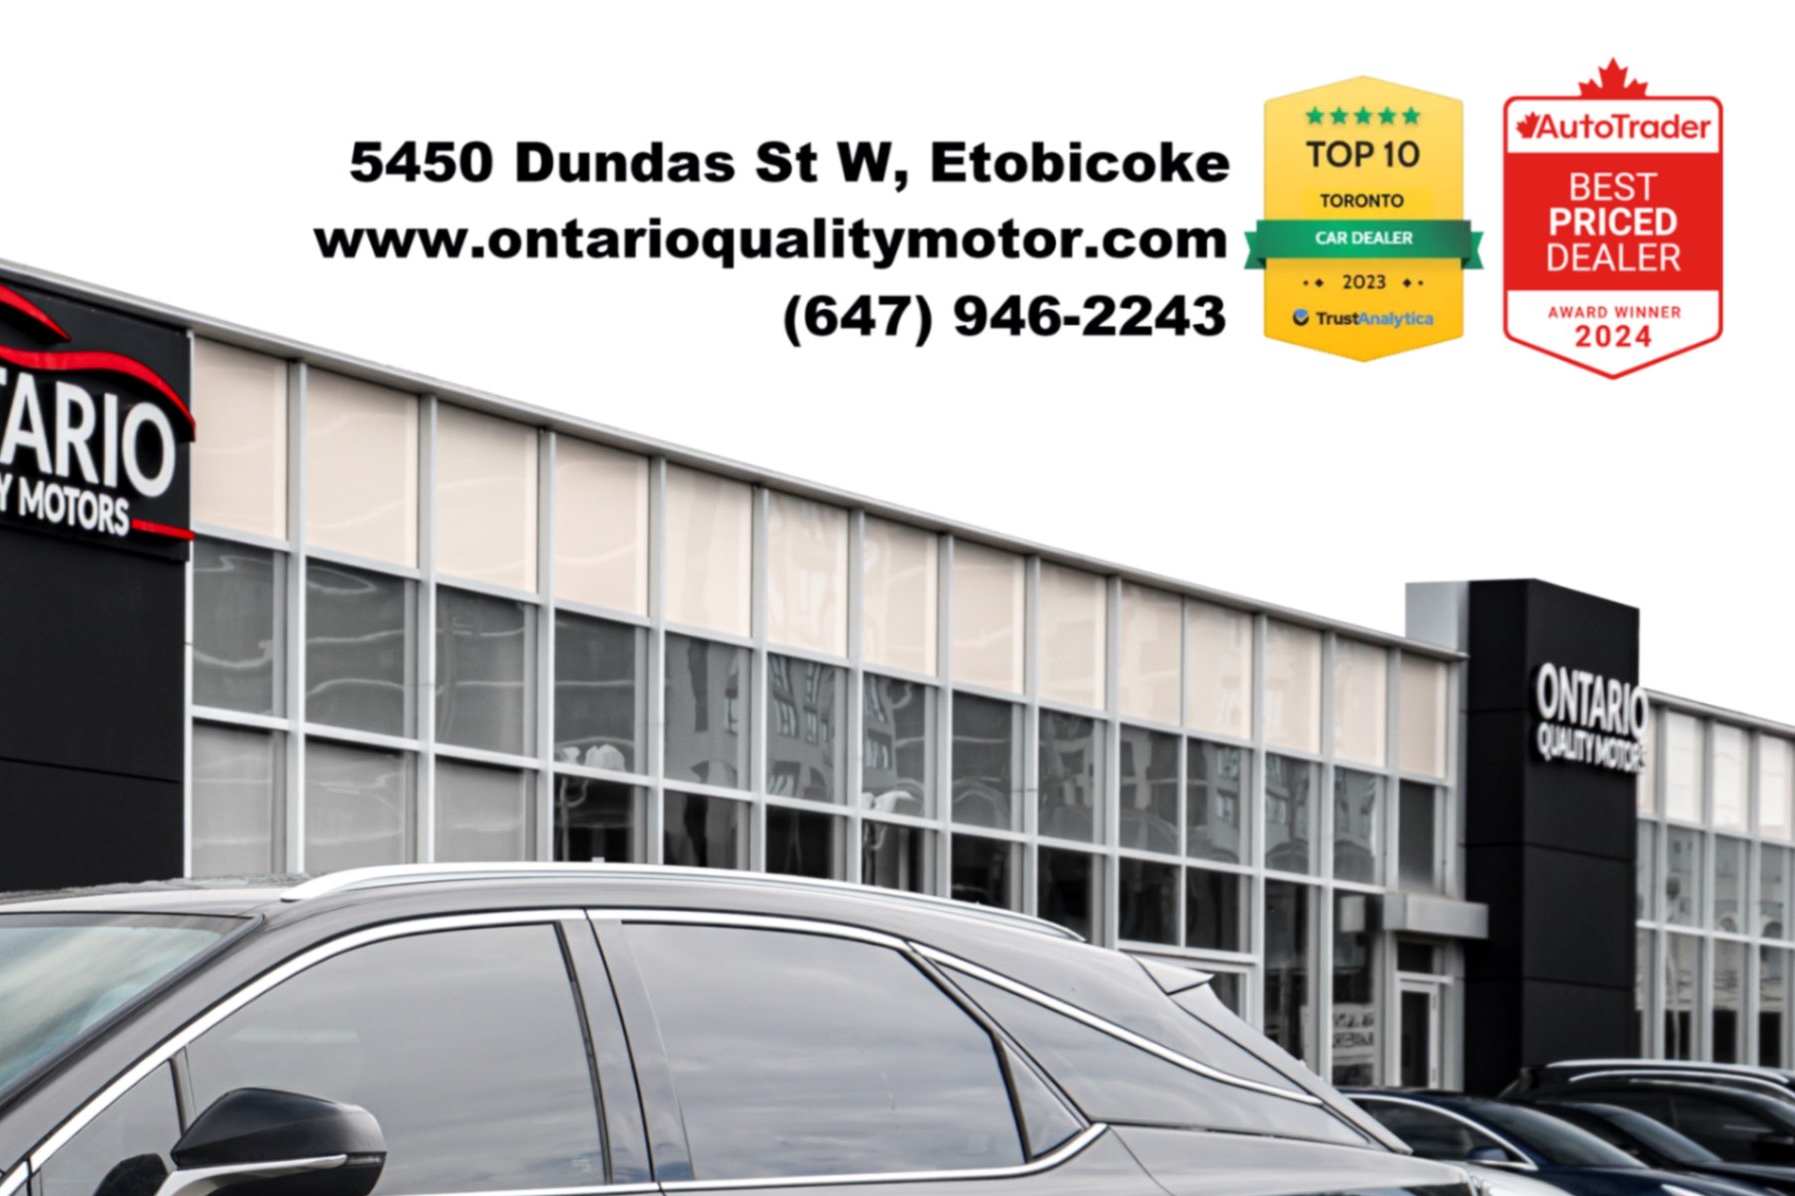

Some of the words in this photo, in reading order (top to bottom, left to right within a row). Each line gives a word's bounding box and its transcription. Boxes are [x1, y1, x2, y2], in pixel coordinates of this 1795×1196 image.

[18, 476, 131, 537] MOTORS
[1536, 661, 1649, 741] ONTARIO
[1537, 721, 1596, 762] QUALITY
[1595, 733, 1647, 774] MOTORS
